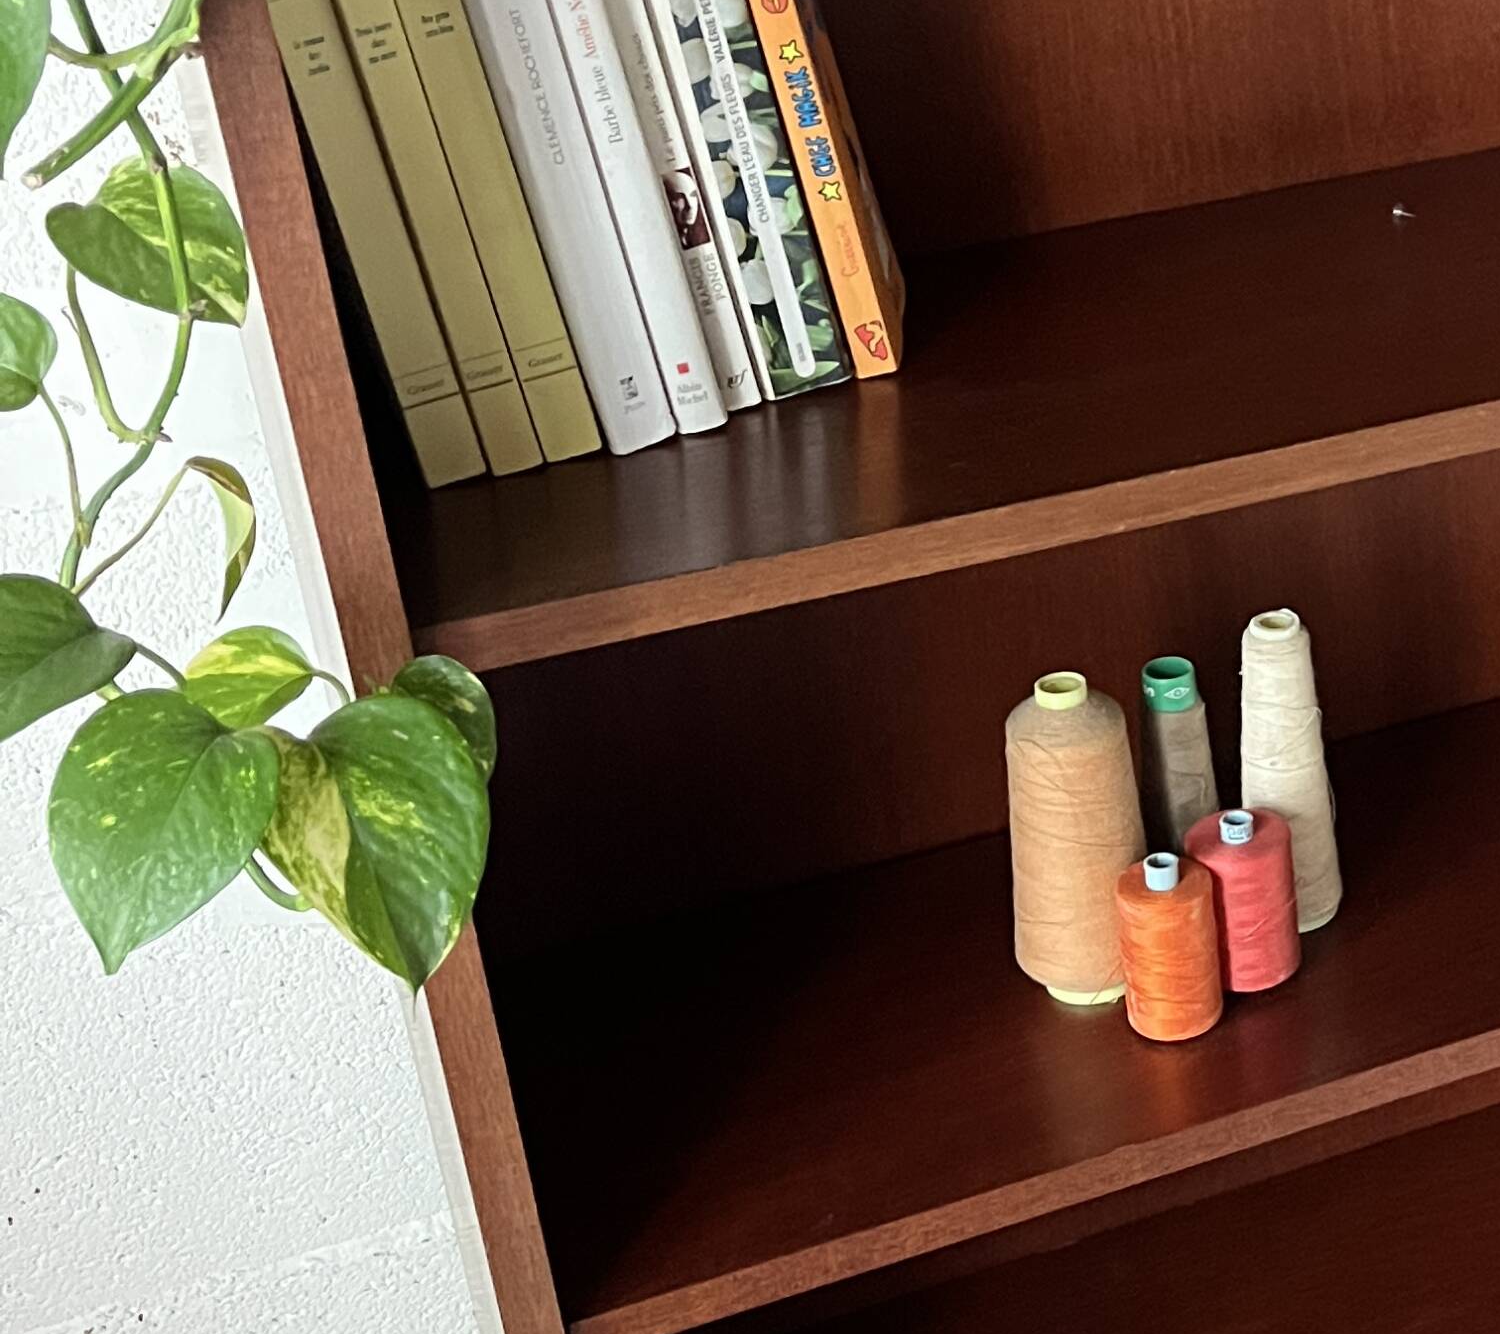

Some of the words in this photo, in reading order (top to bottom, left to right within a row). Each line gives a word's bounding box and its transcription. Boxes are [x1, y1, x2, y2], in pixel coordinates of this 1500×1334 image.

[508, 8, 543, 90] ROCHEFORT
[576, 14, 599, 58] Amélie
[705, 17, 726, 64] VALÉRIE
[592, 66, 612, 103] bleue
[720, 73, 740, 115] FLEURS
[602, 104, 624, 144] Barbe
[732, 117, 747, 140] DES
[739, 142, 756, 172] L'EAU
[805, 136, 836, 177] CHEF
[748, 173, 769, 224] CHANGER
[703, 253, 727, 301] PONGE
